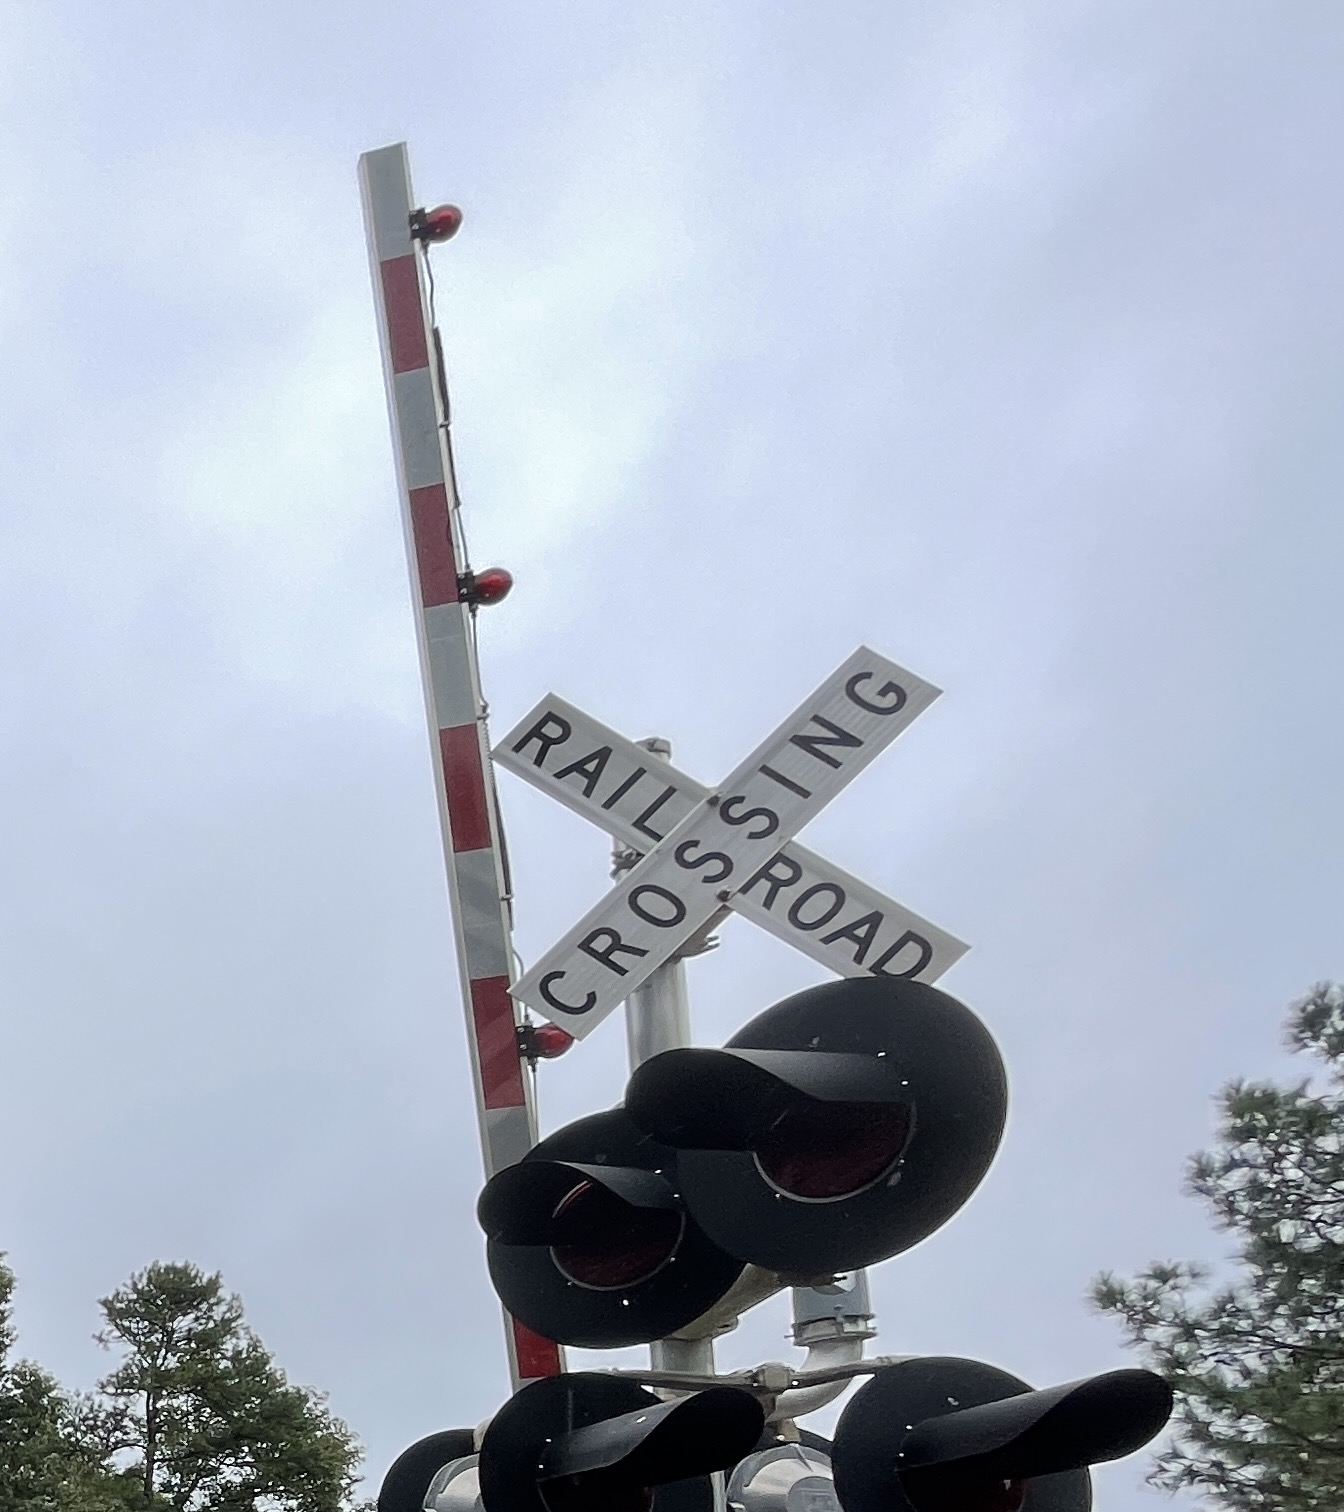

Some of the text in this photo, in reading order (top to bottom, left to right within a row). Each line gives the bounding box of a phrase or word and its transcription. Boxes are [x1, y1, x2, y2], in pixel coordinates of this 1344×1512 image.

[511, 710, 933, 979] RAIL ROAD
[538, 671, 908, 1016] CROSSING
